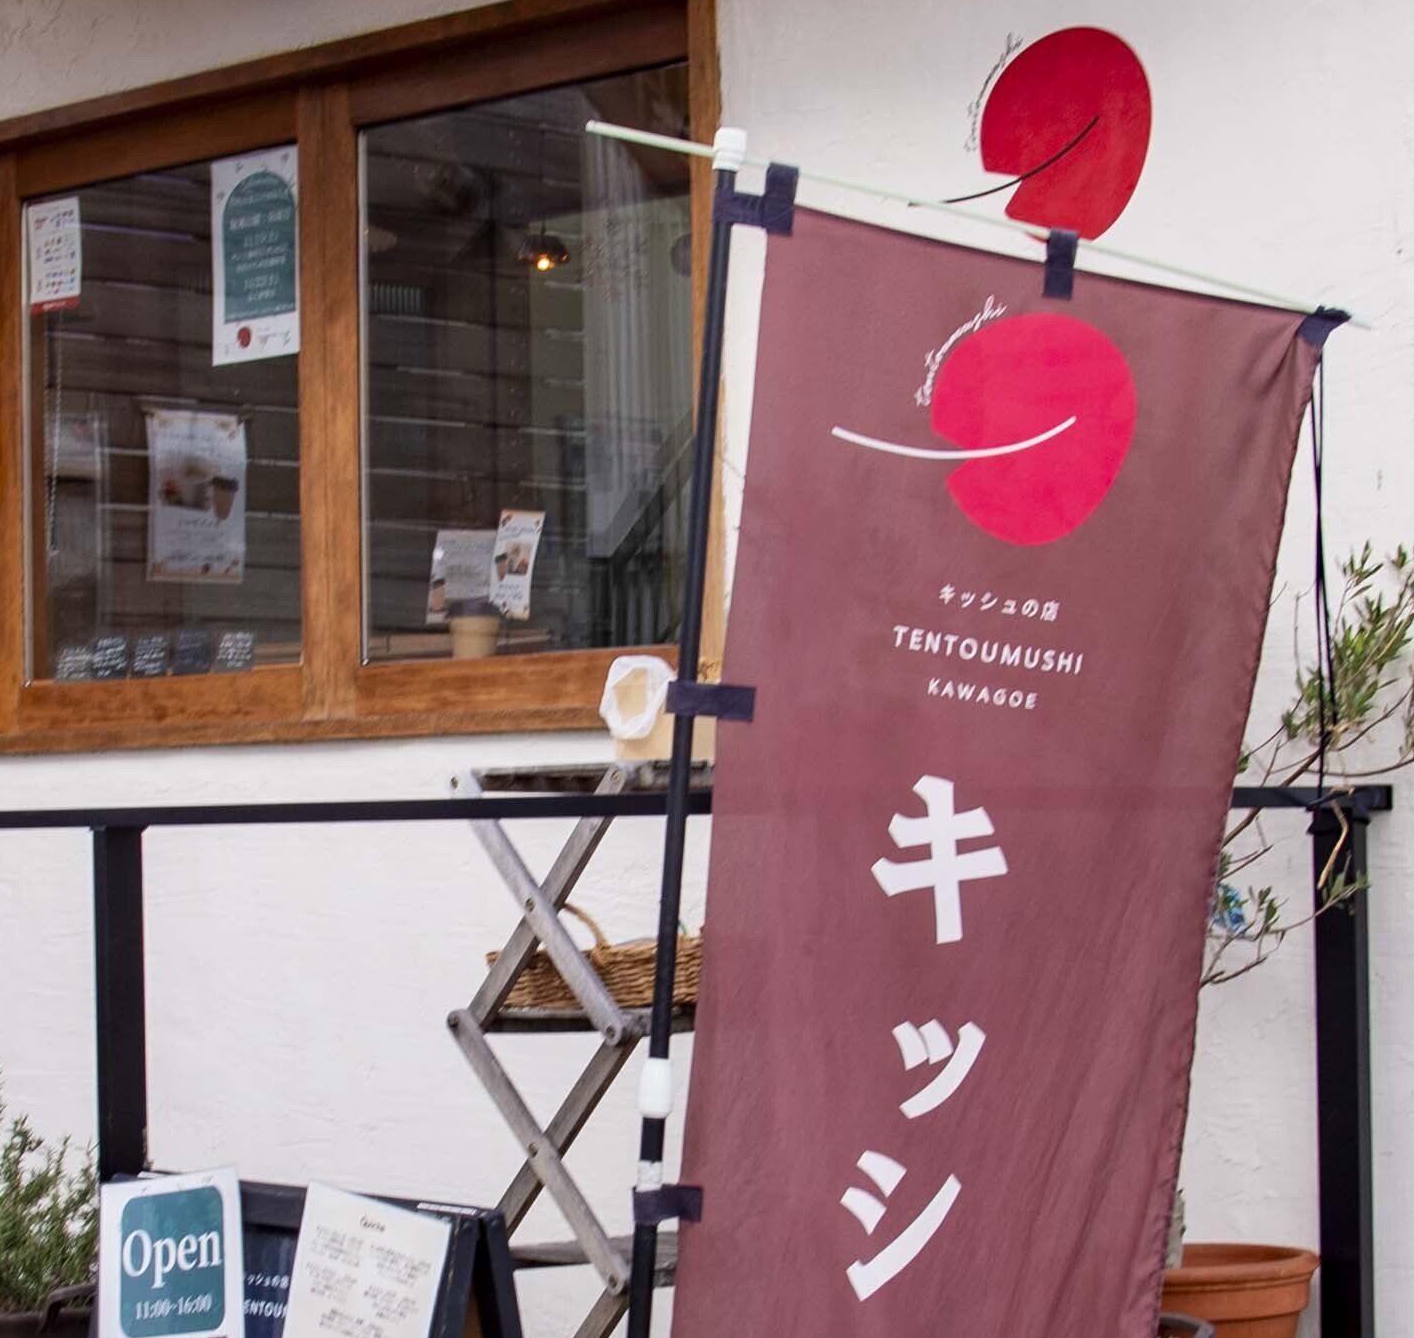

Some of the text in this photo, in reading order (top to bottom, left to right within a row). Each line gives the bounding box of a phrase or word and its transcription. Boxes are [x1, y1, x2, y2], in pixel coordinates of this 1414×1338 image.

[939, 583, 1060, 622] キッシュの店
[892, 624, 1084, 675] TENTOUMUSHI
[927, 677, 1038, 710] KAWAGOE
[122, 1229, 222, 1290] Open
[246, 1273, 289, 1289] ッシュの店
[244, 1298, 288, 1318] ENTOU
